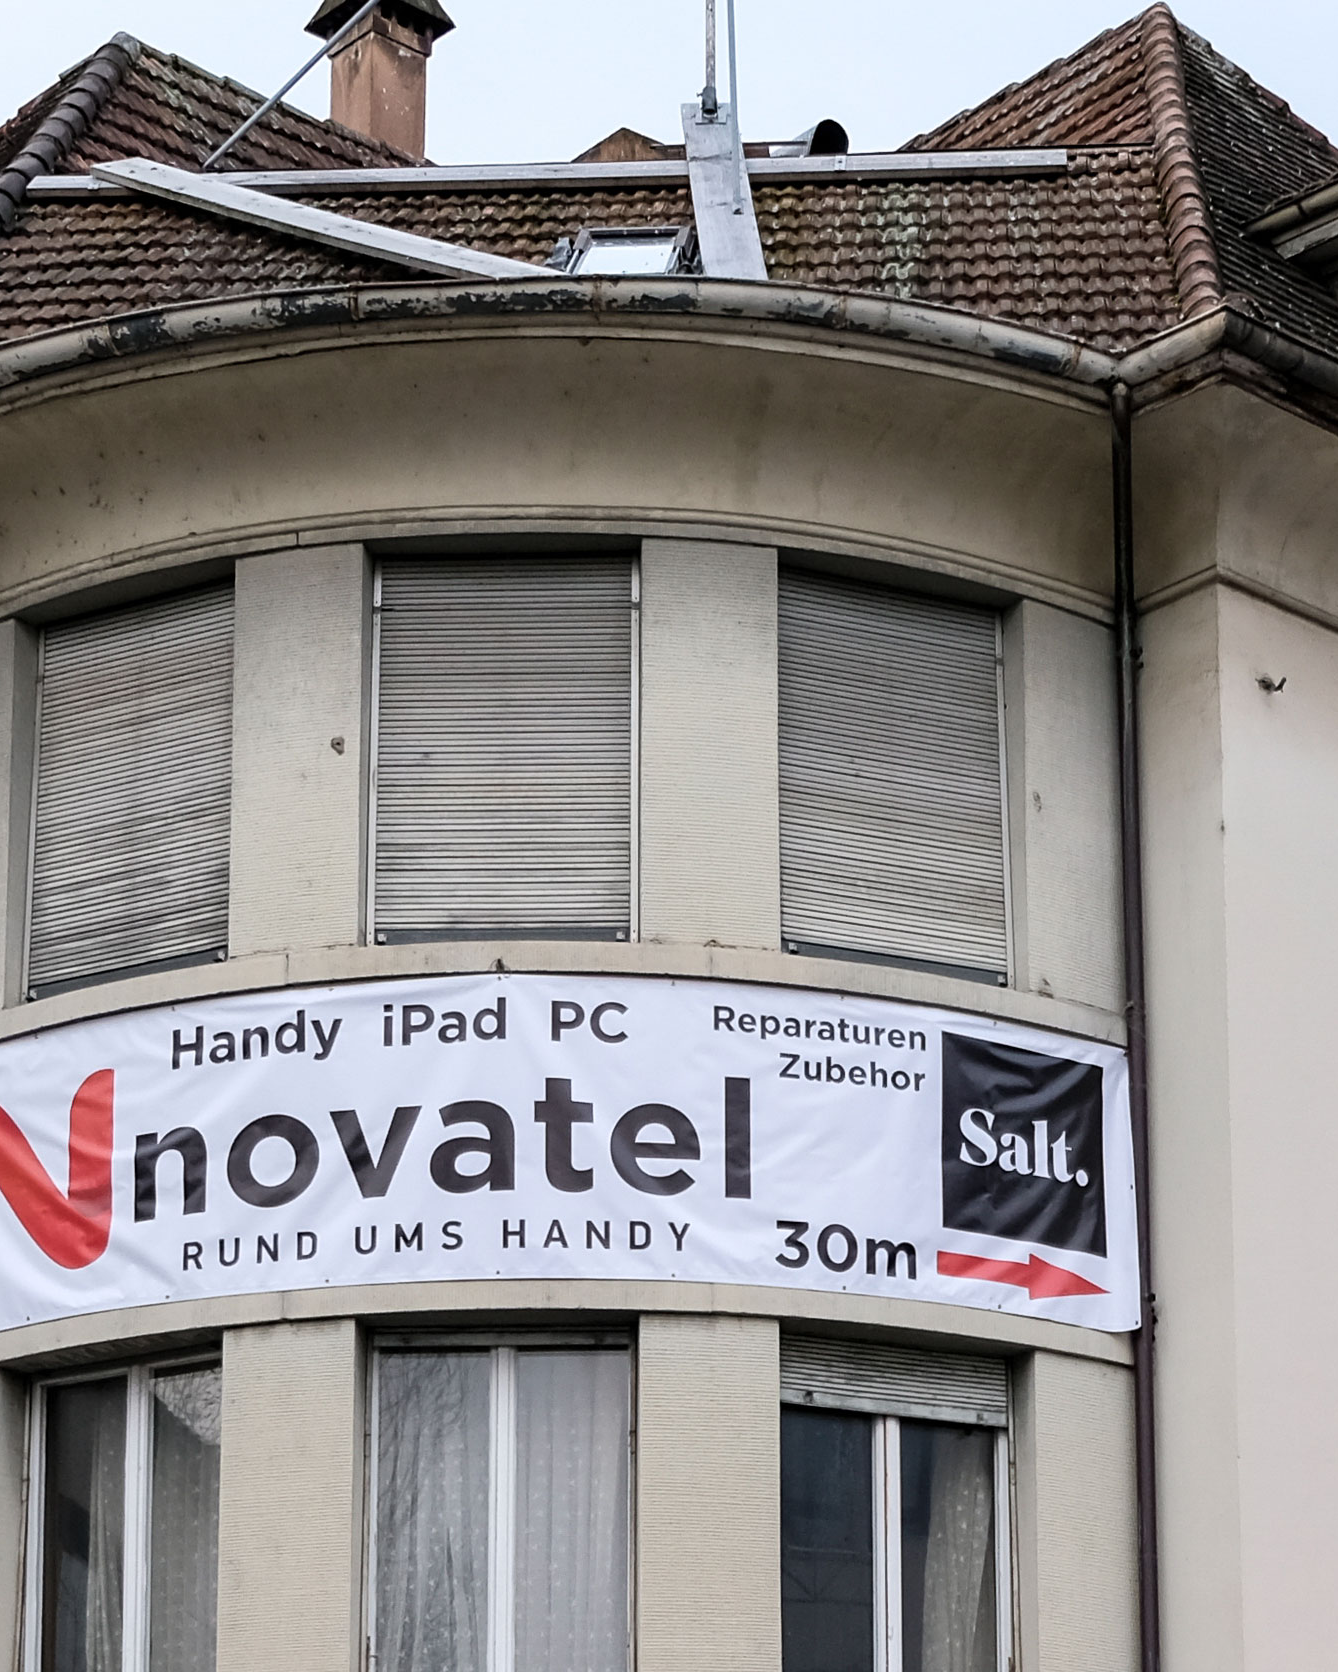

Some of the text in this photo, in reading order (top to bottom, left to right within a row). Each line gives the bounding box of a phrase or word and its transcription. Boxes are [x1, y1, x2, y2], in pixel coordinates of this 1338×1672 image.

[170, 998, 630, 1070] Handy iPad PC
[713, 1005, 928, 1053] Reparaturen
[778, 1052, 926, 1092] Zubehor
[132, 1076, 751, 1223] novatel
[959, 1108, 1089, 1187] Salt.
[182, 1218, 692, 1271] RUND UMS HANDY
[775, 1220, 918, 1280] 30m
